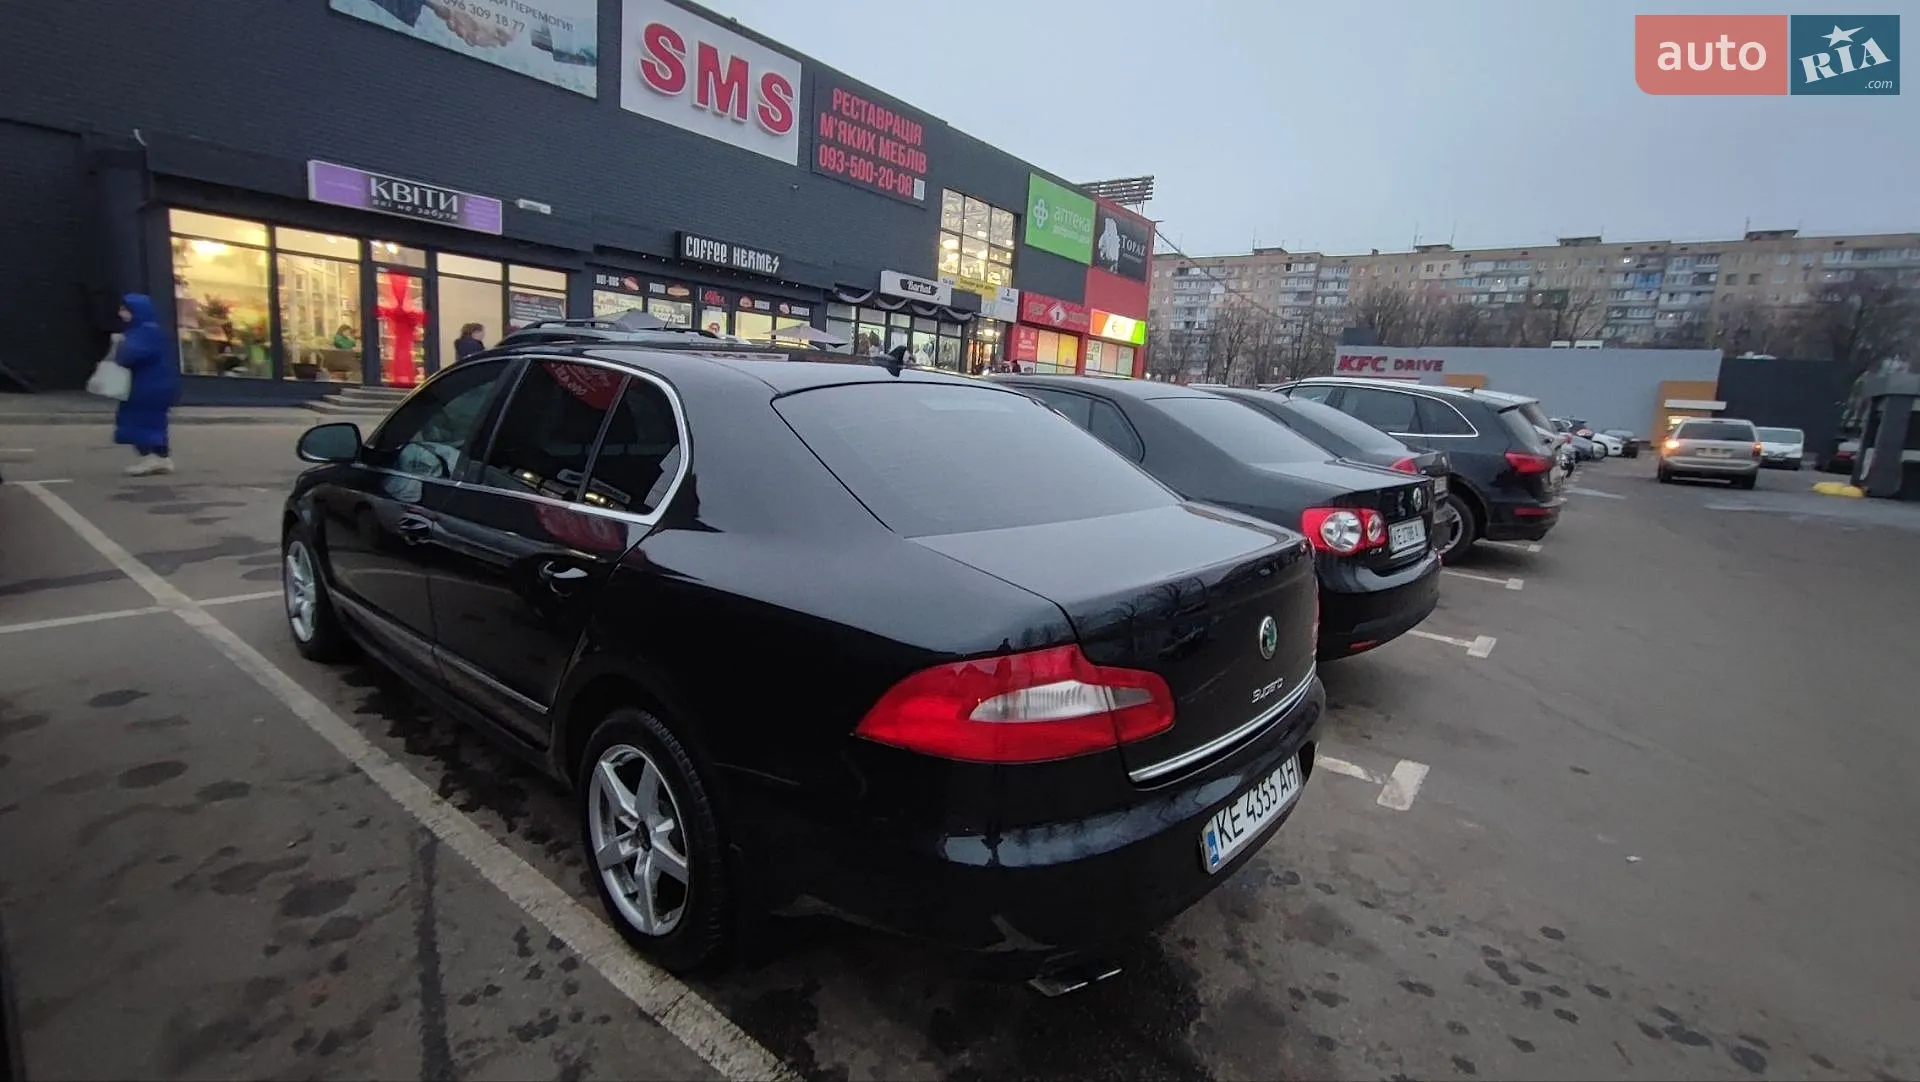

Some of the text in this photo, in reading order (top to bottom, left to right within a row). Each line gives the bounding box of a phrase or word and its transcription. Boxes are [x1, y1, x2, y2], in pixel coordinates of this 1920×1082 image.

[470, 3, 491, 19] 309
[511, 19, 526, 33] 77
[639, 22, 795, 136] SMS
[832, 87, 923, 146] РЕСТАВРАЦІЯ
[819, 111, 928, 174] М'ЯКИХ МЕБЛІВ
[371, 177, 459, 213] КВІТИ
[732, 245, 781, 275] HERMES
[1337, 355, 1444, 373] KFC DRIVE
[1215, 753, 1297, 850] KE 4355 AH
